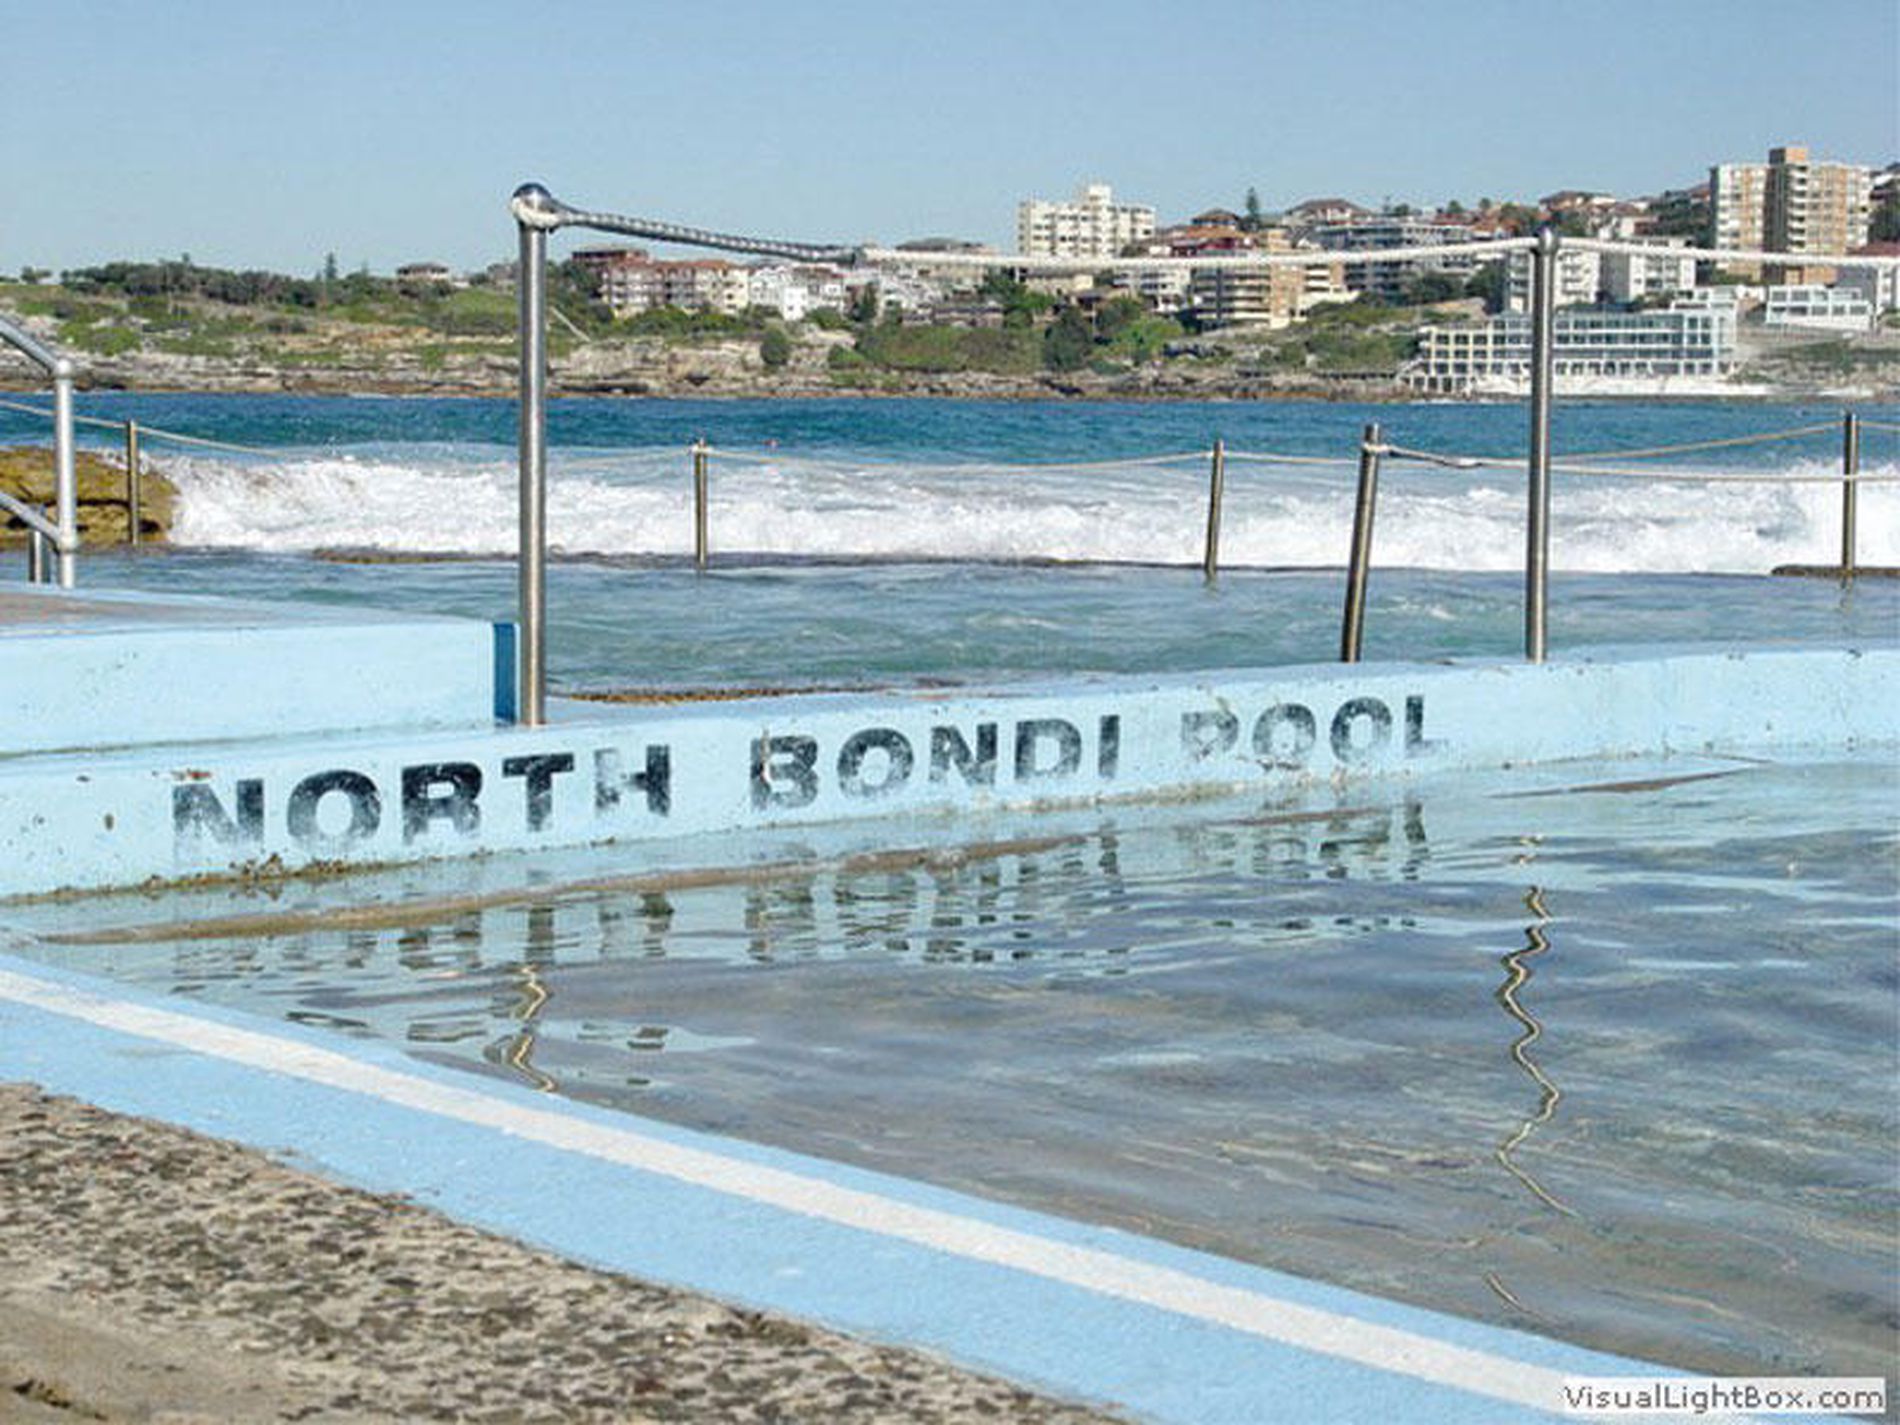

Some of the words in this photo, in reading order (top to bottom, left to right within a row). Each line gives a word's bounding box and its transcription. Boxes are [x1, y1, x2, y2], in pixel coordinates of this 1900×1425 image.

[172, 744, 671, 852] NORTH
[750, 714, 1121, 812] BONDI
[1181, 695, 1446, 770] POOL
